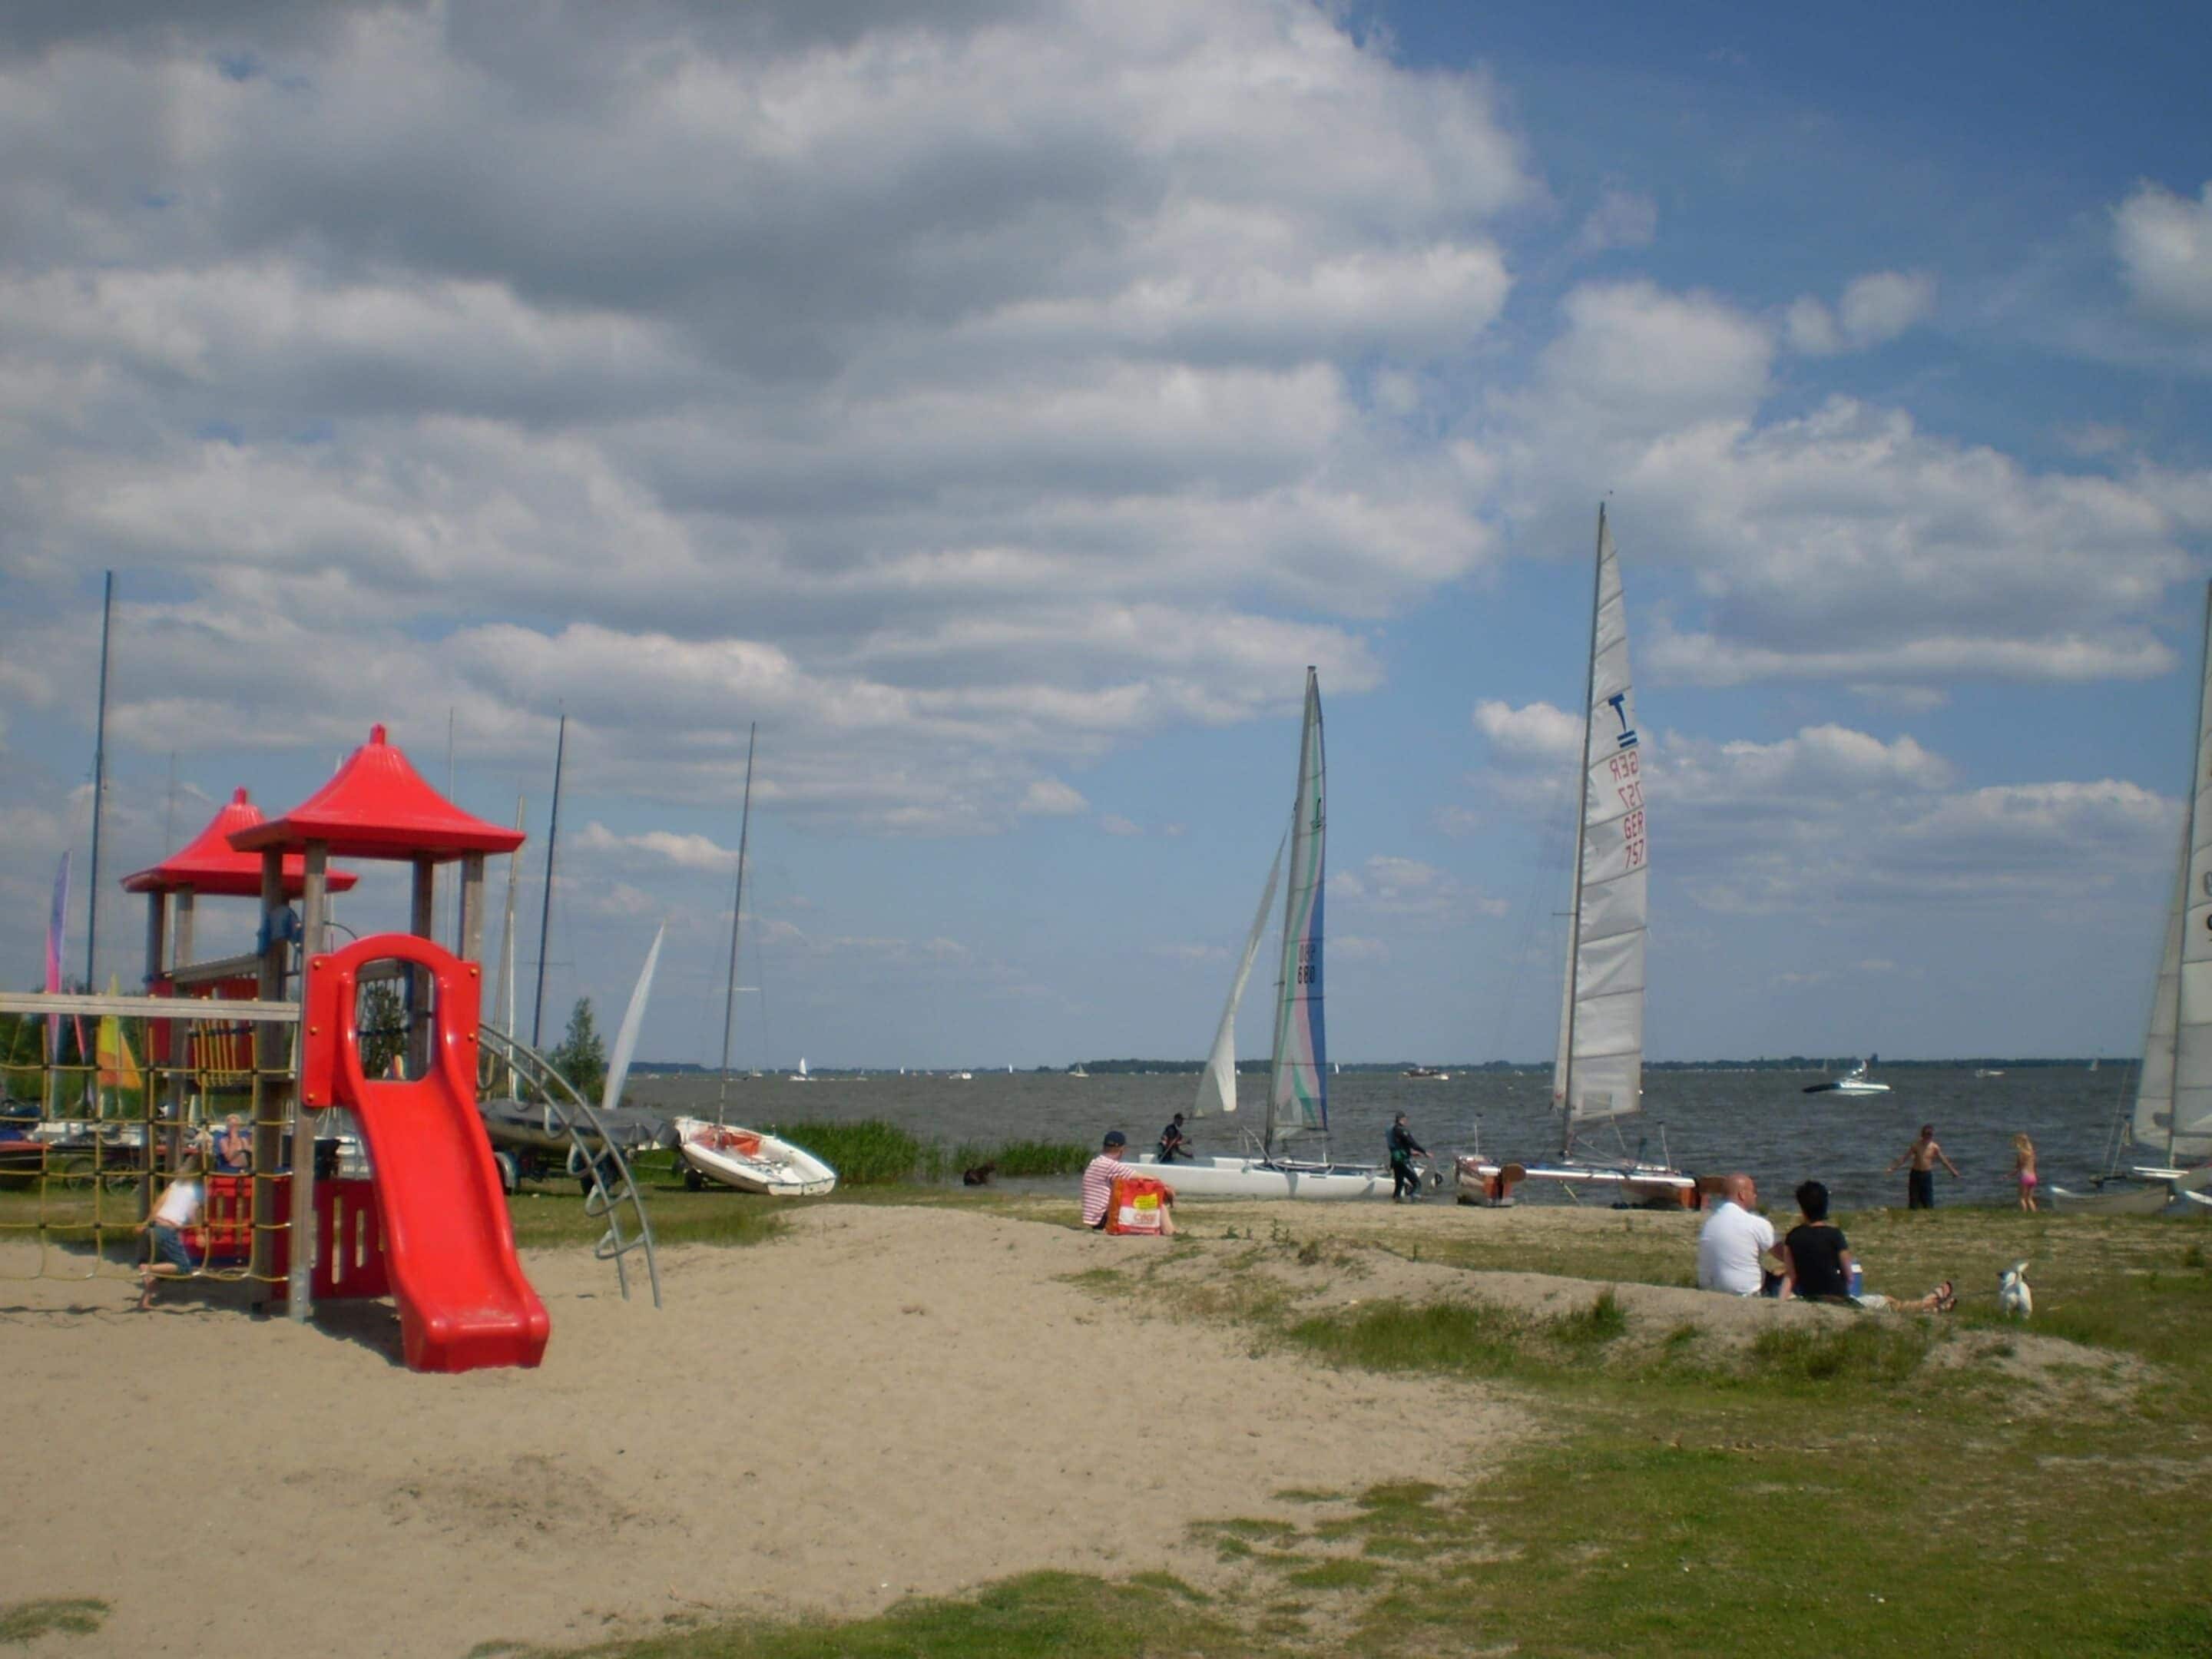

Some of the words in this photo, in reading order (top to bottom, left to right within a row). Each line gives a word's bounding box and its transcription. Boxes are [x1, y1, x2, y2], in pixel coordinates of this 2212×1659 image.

[1625, 812, 1644, 839] GER
[1625, 840, 1644, 868] 757
[1298, 965, 1315, 984] 680
